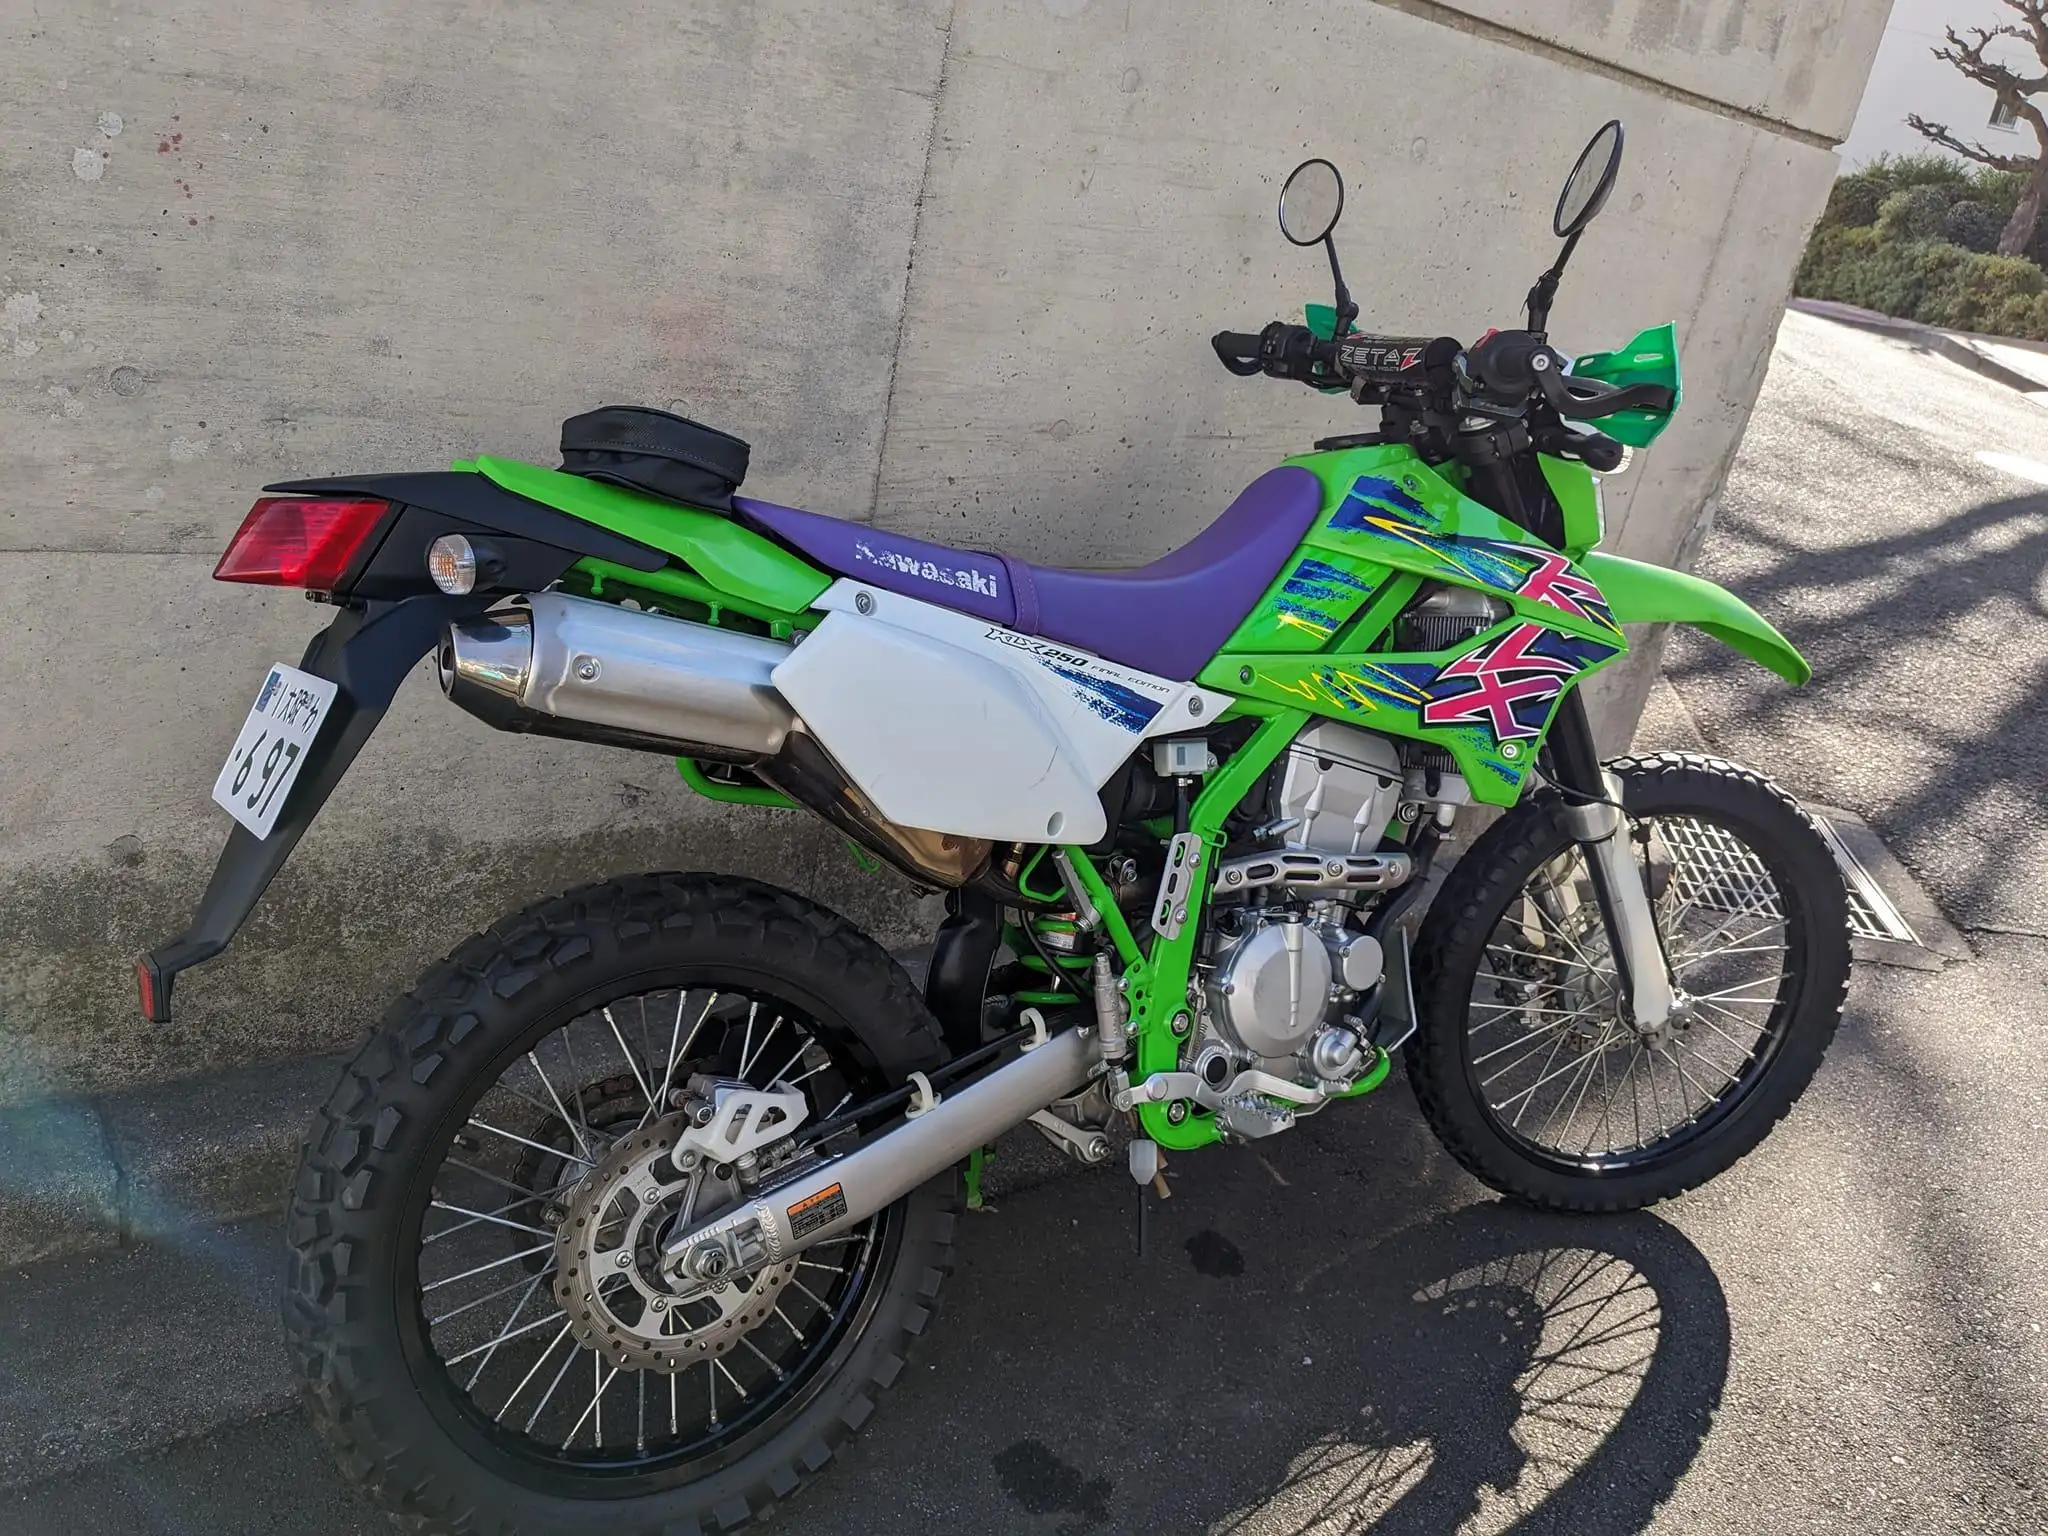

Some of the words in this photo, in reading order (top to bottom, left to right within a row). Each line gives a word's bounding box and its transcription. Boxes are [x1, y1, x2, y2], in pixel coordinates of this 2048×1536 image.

[1341, 345, 1400, 366] ZETA
[984, 627, 1047, 655] KLX
[1043, 648, 1089, 667] 250
[1091, 665, 1124, 680] FINAL
[1127, 677, 1170, 694] EDITION
